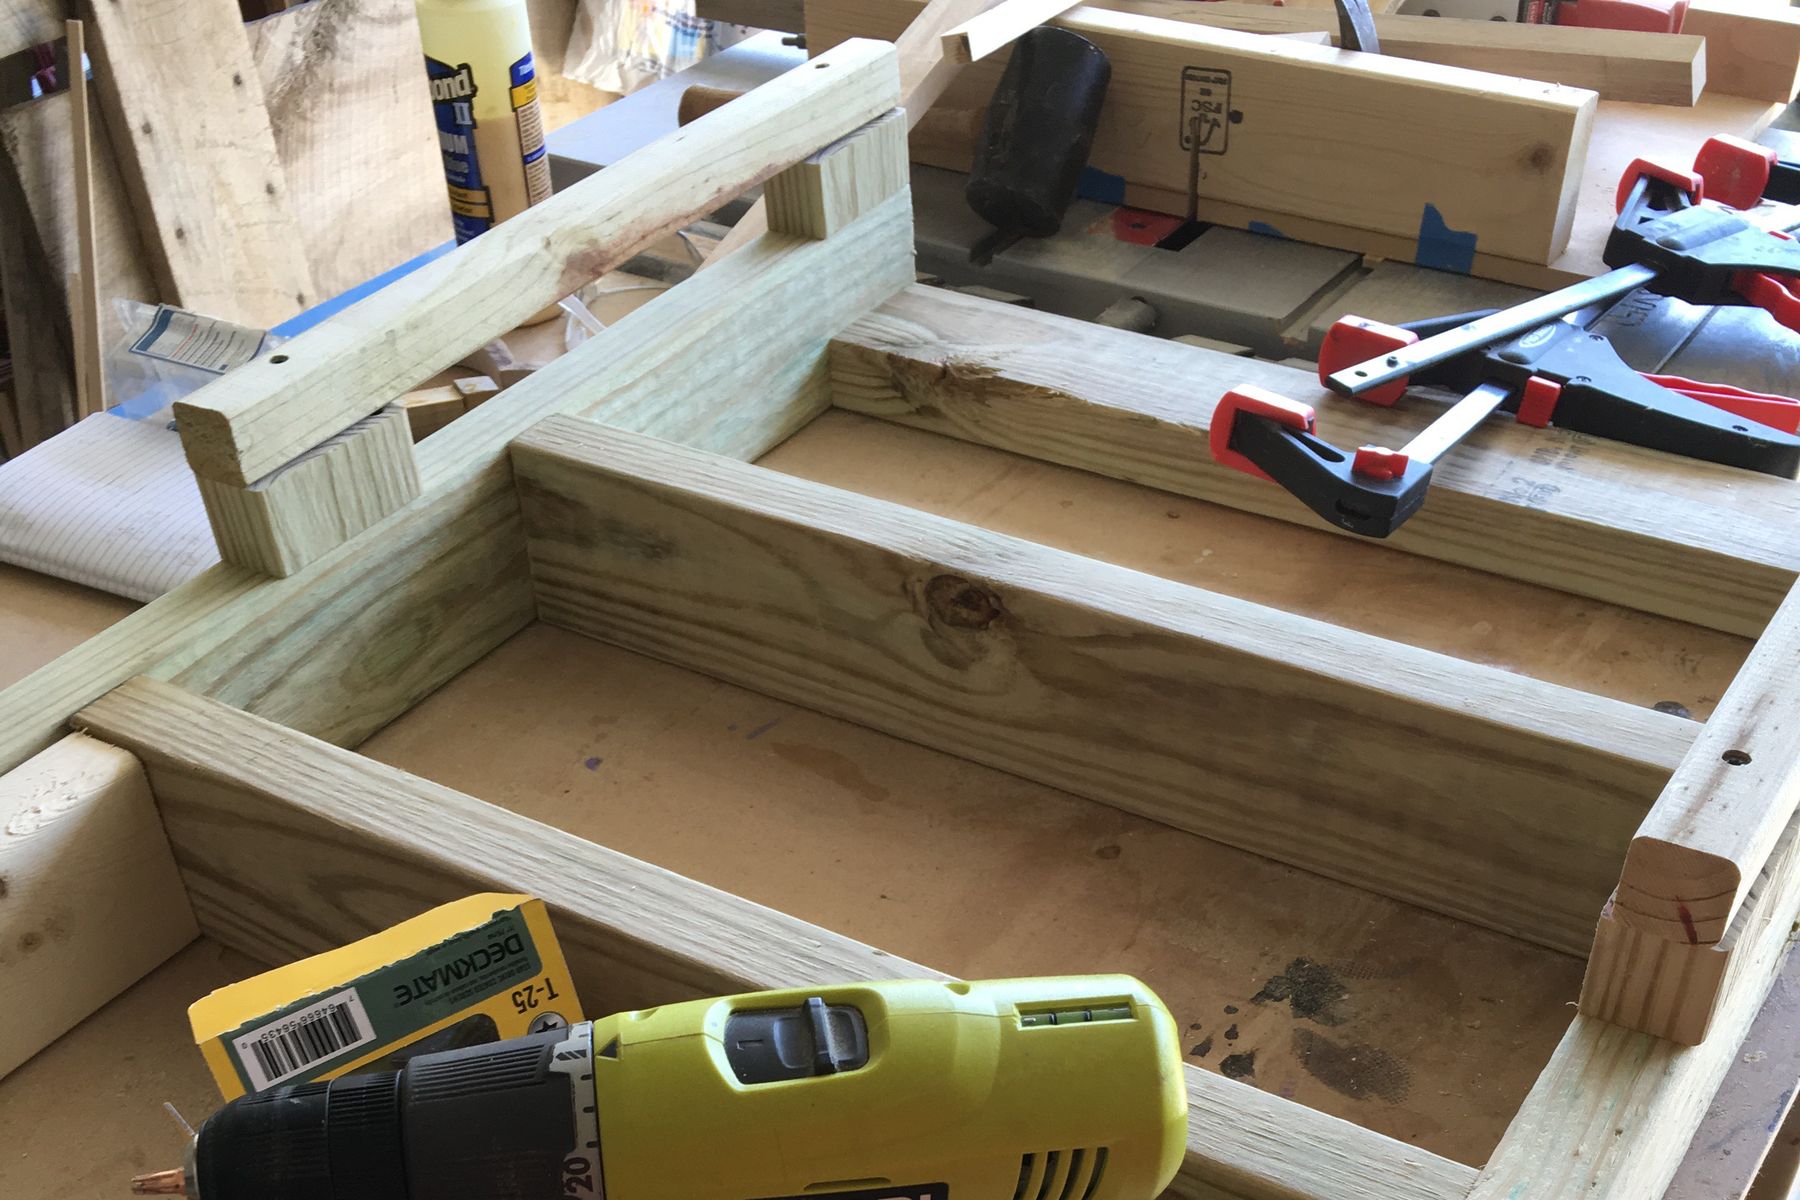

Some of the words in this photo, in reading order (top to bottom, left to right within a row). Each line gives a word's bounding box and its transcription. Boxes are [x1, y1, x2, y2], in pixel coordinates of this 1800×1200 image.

[393, 933, 525, 1006] DECKMATE
[511, 977, 559, 1015] T-25
[564, 1156, 594, 1193] 20
